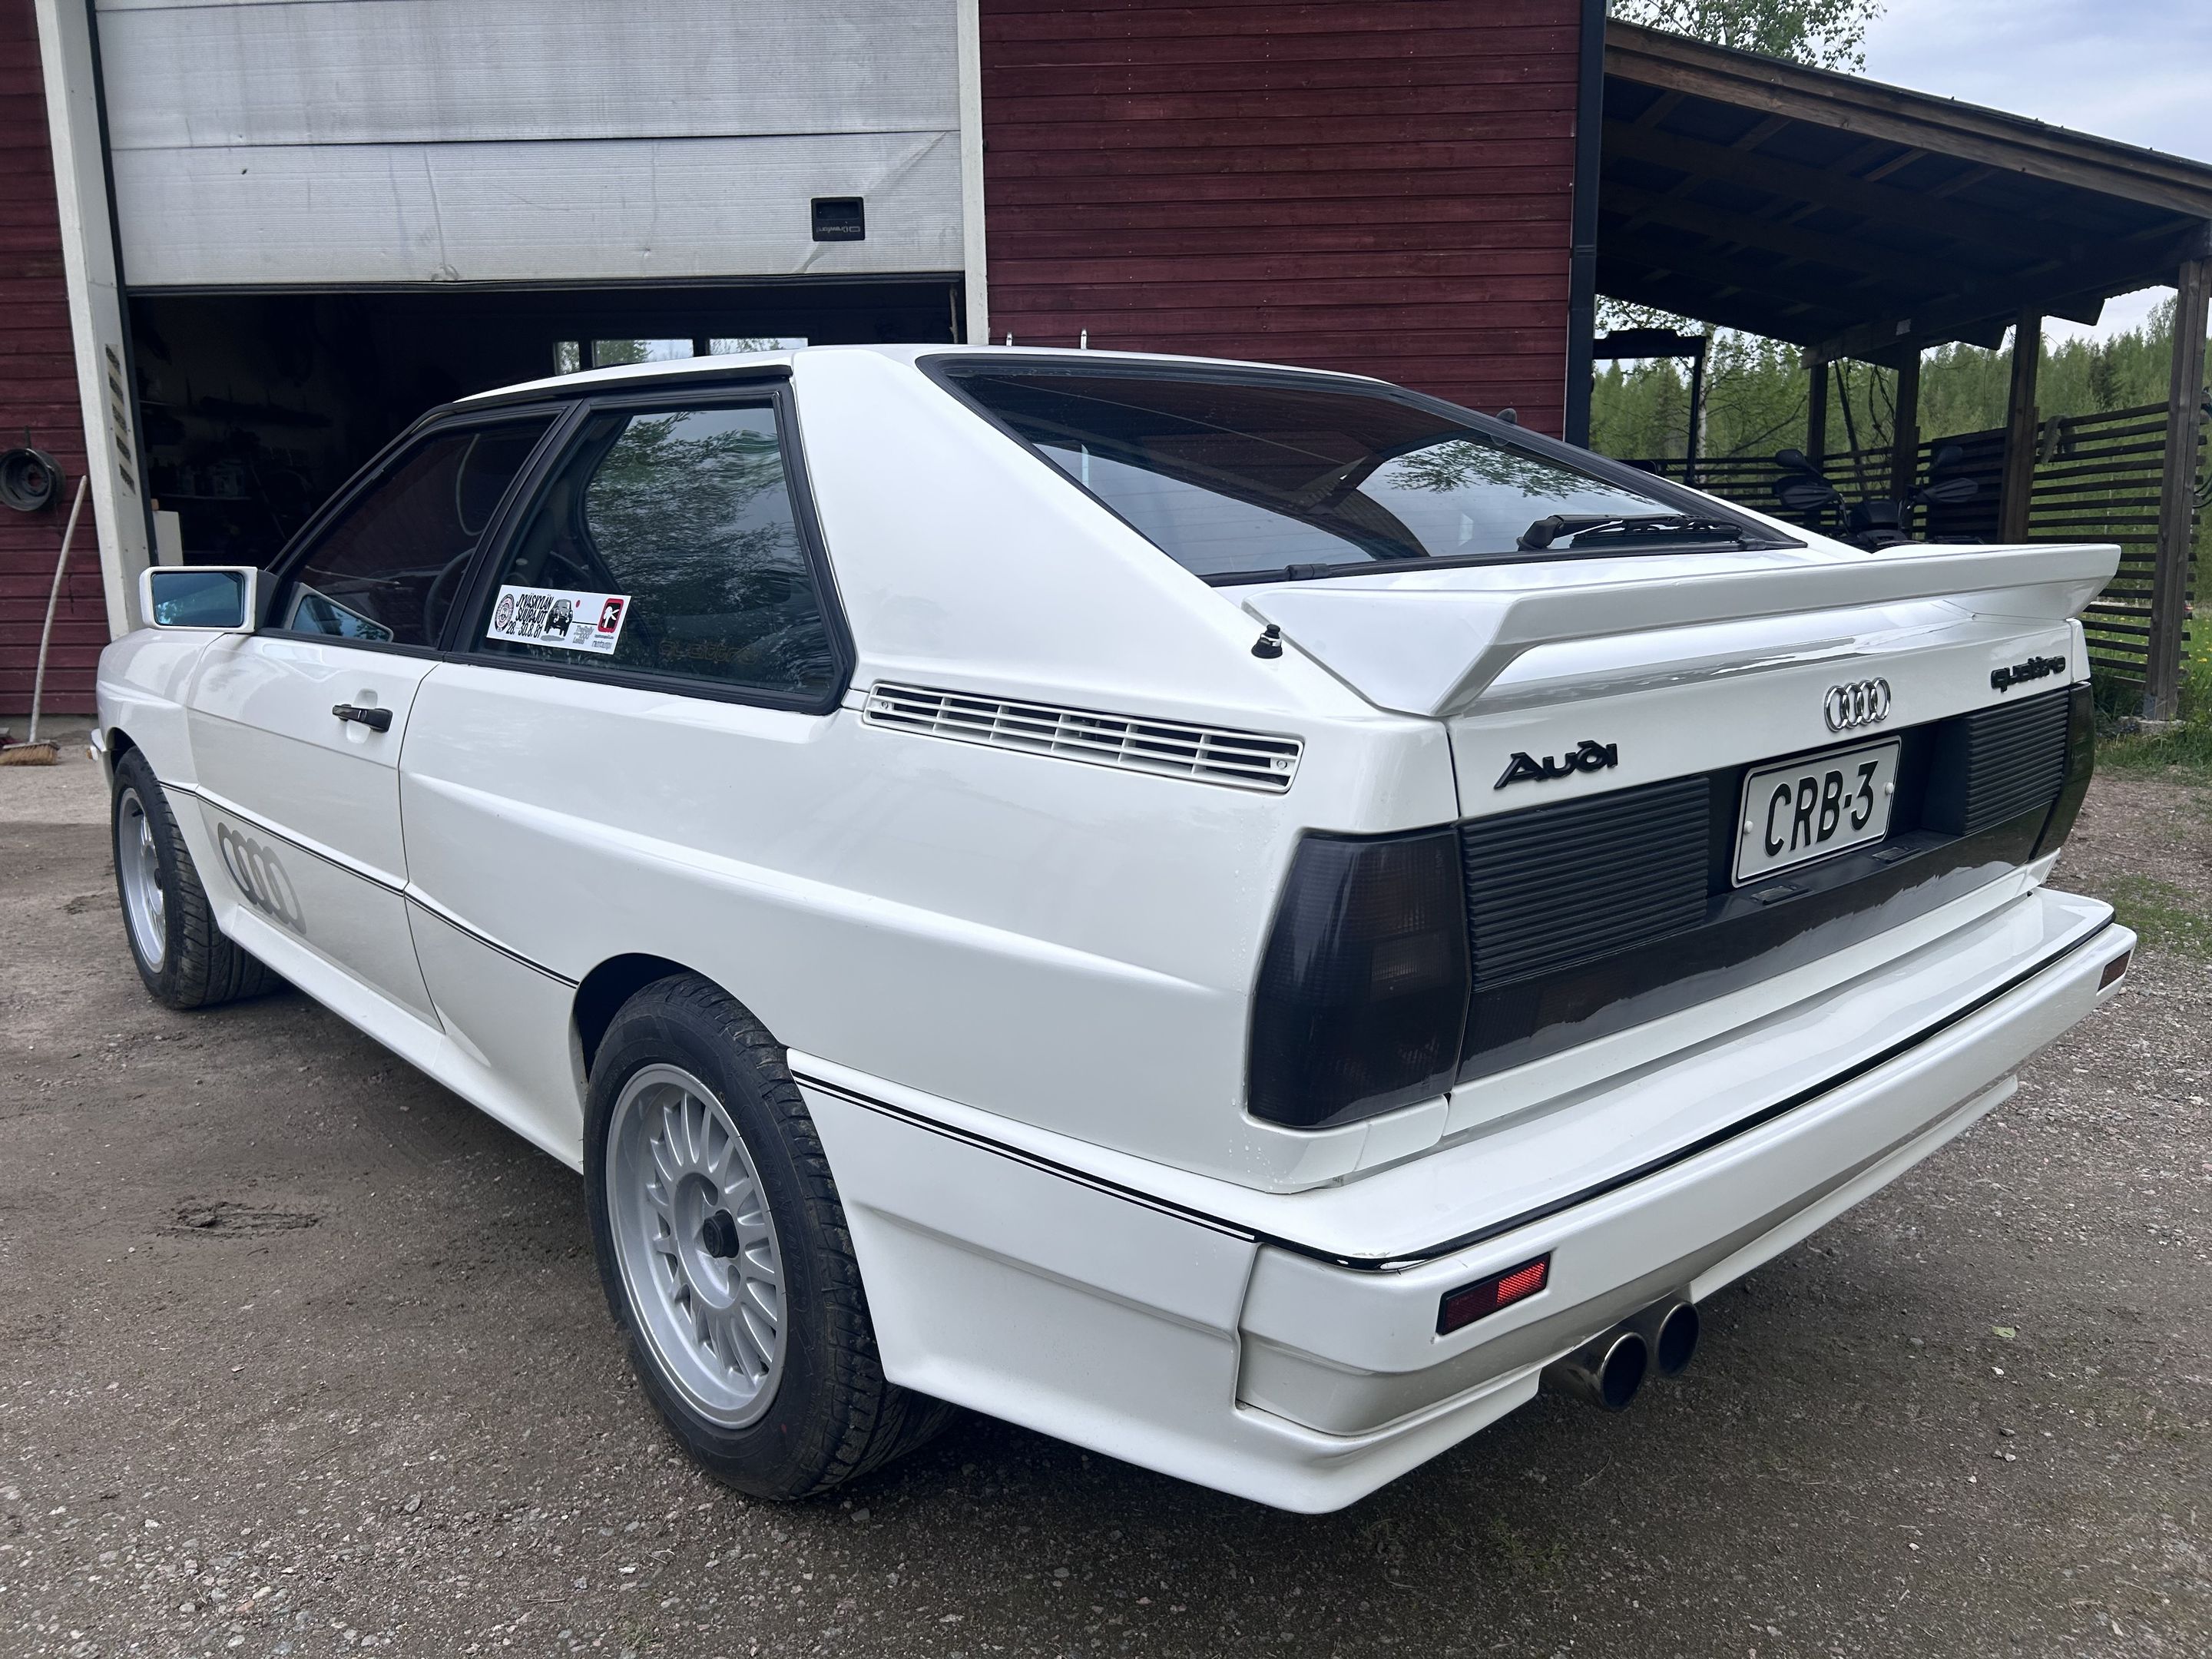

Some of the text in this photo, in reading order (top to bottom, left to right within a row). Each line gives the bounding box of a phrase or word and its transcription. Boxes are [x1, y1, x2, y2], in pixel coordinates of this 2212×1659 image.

[515, 592, 554, 611] JYVÄSKYLÄN
[515, 608, 548, 624] SUURAJOT
[1991, 655, 2066, 693] quattro
[1493, 740, 1618, 790] Audi
[1764, 760, 1879, 857] CRB-3
